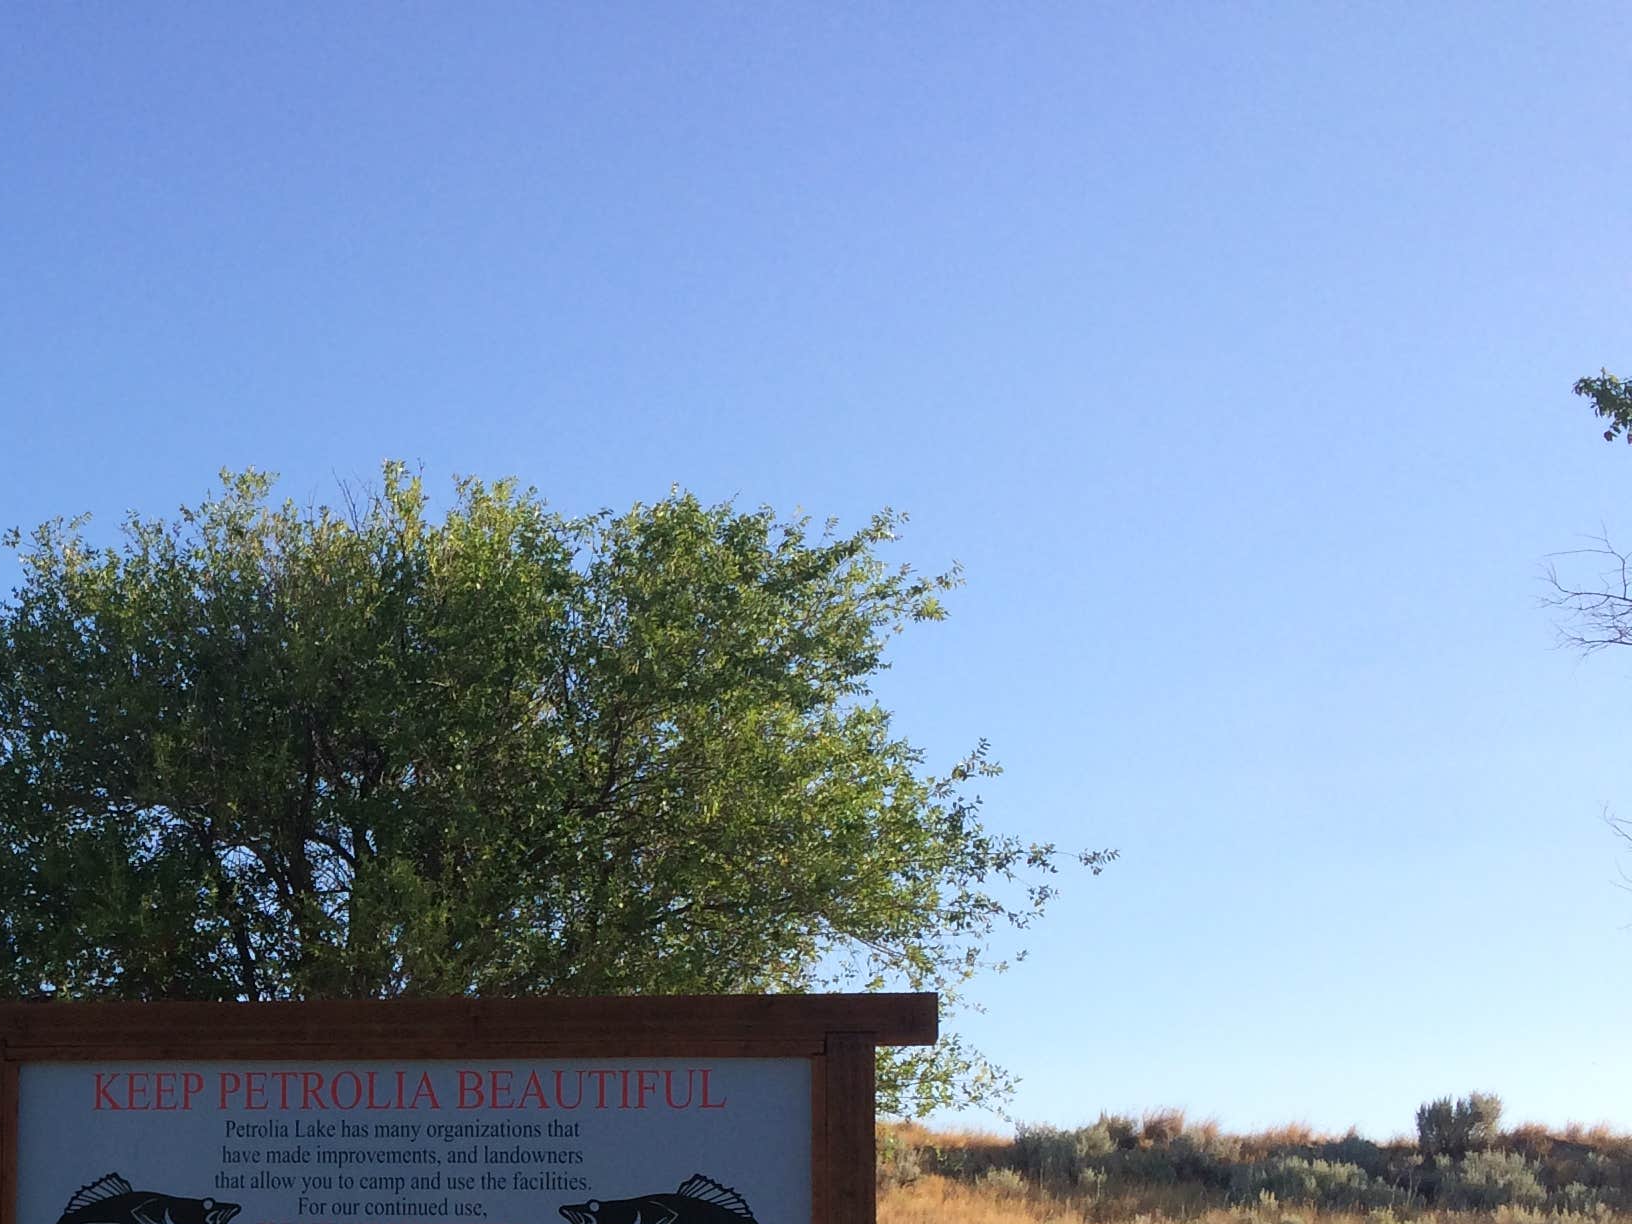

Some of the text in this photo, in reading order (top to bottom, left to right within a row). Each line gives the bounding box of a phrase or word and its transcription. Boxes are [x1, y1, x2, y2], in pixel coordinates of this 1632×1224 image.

[93, 1069, 727, 1112] KEEP PETROLIA BEAUTIFUL
[225, 1119, 579, 1142] Petrolia Lake has many organizations that
[222, 1146, 584, 1169] have made improvements, and landowners
[215, 1172, 592, 1194] that allow you to camp and use the facilities.
[298, 1198, 487, 1219] For our continued use,
